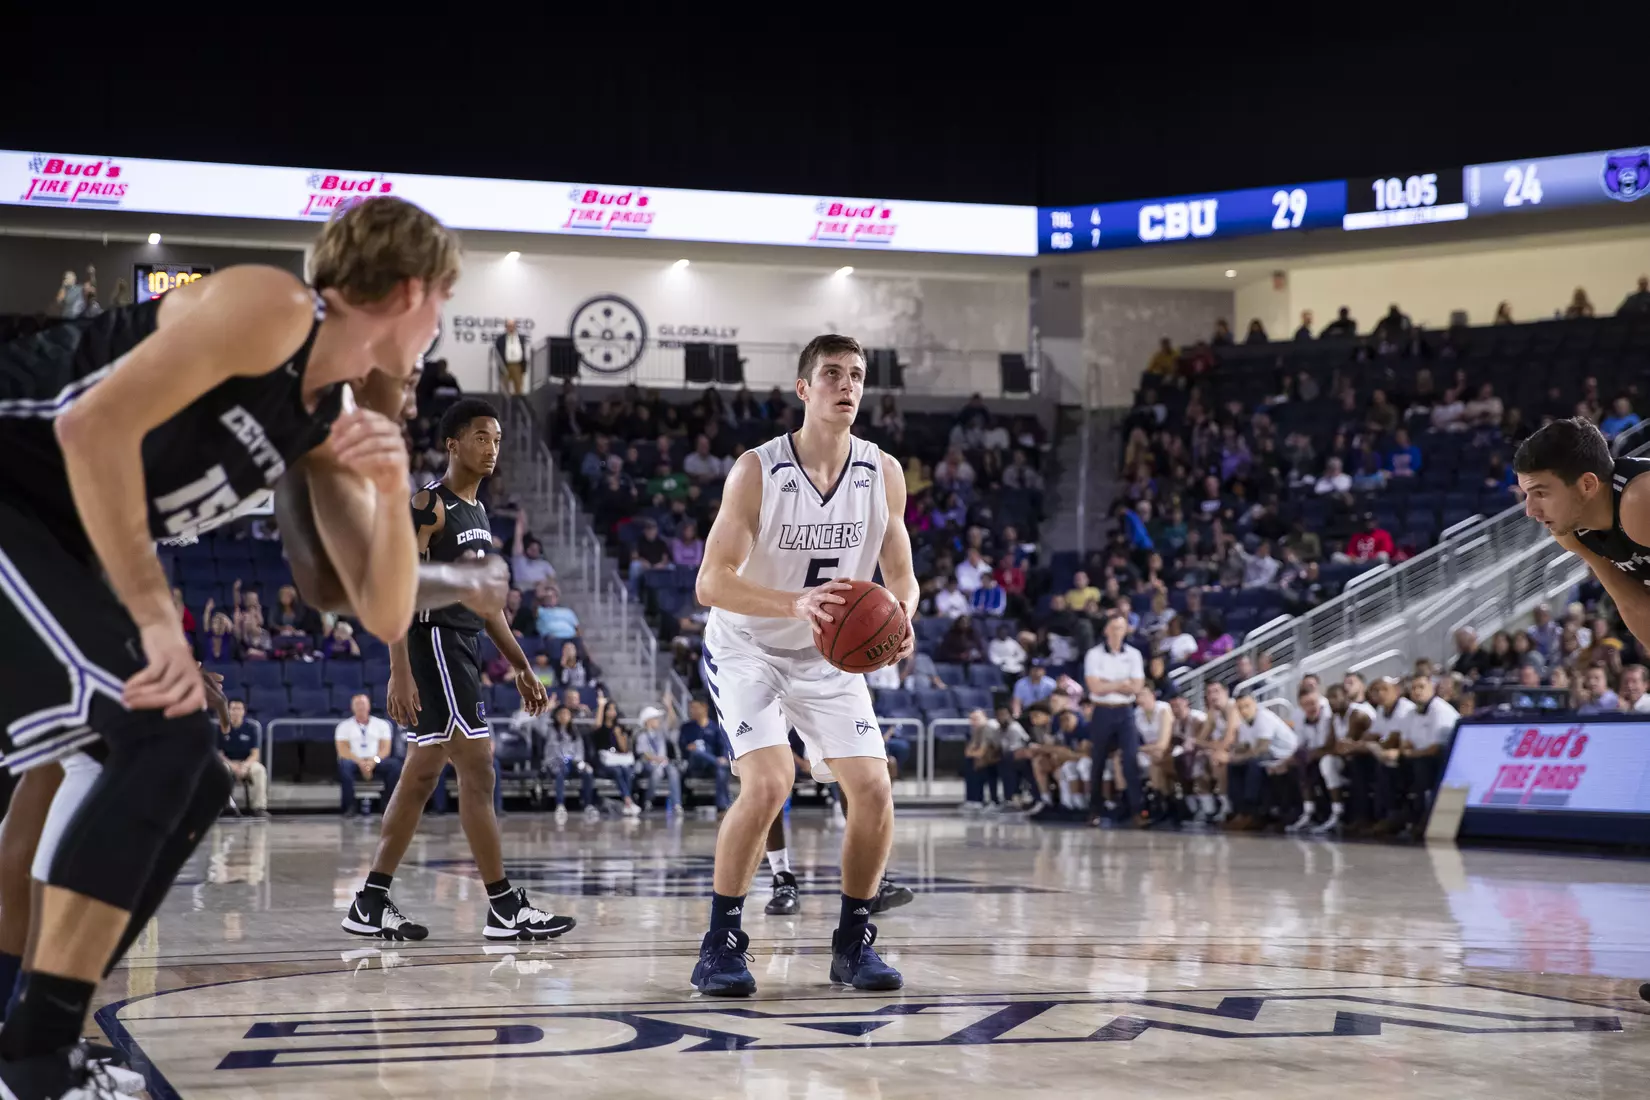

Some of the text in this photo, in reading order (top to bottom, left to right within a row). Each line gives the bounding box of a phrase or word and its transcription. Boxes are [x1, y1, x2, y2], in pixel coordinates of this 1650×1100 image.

[43, 157, 121, 178] Bud's
[25, 177, 128, 203] TIRE PROS
[1503, 164, 1543, 207] 24
[1138, 198, 1218, 243] CBU
[1271, 188, 1308, 230] 29
[452, 315, 536, 332] EQUIPED
[657, 325, 740, 340] GLOBALLY
[853, 479, 870, 489] WAC
[778, 521, 863, 551] LANCERS
[803, 557, 840, 589] 5
[1513, 724, 1590, 758] Bud's
